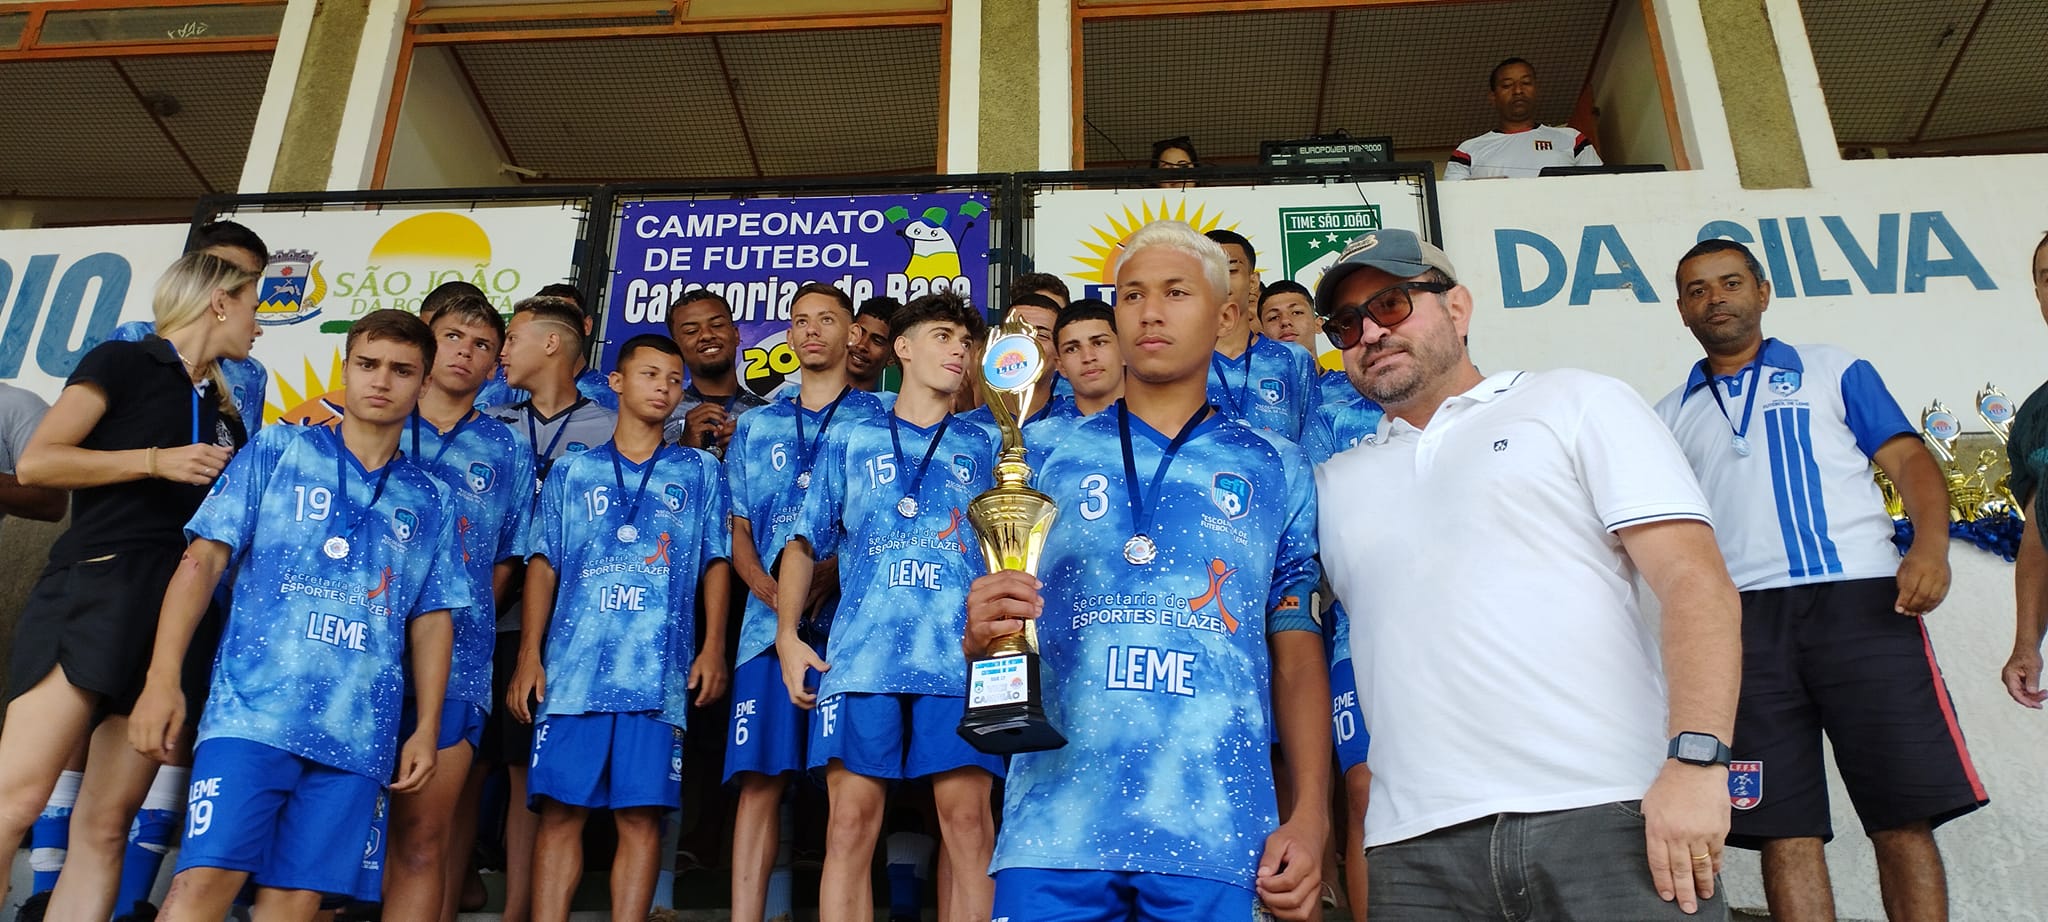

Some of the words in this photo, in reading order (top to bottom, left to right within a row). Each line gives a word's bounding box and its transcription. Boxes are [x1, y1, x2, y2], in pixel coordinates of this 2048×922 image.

[1300, 145, 1347, 154] EUROPOWER
[636, 210, 885, 238] CAMPEONATO
[1291, 216, 1316, 229] TIME
[1318, 213, 1341, 228] SÃO
[1343, 212, 1371, 227] JOÃO
[644, 247, 693, 272] DE
[703, 243, 869, 271] FUTEBOL
[1494, 224, 1661, 309] DA
[333, 266, 412, 297] SÃO
[0, 252, 133, 379] IO
[771, 442, 787, 472] 6
[865, 453, 896, 490] 15
[294, 485, 332, 522] 19
[584, 486, 609, 521] 16
[1079, 473, 1109, 521] 3
[283, 572, 348, 590] secretaria
[638, 564, 671, 575] LAZER
[889, 560, 942, 590] LEME
[280, 582, 347, 602] ESPORTES
[348, 594, 358, 606] E
[1073, 592, 1157, 612] secretaria
[1166, 594, 1187, 609] de
[306, 612, 368, 651] LEME
[1072, 609, 1156, 630] ESPORTES
[1161, 611, 1173, 625] E
[1176, 613, 1228, 636] LAZER
[1106, 646, 1197, 698] LEME
[734, 699, 757, 719] EME
[1332, 691, 1355, 715] EME
[735, 717, 749, 746] 6
[1333, 710, 1356, 746] 10
[188, 777, 223, 803] LEME
[188, 799, 214, 838] 19
